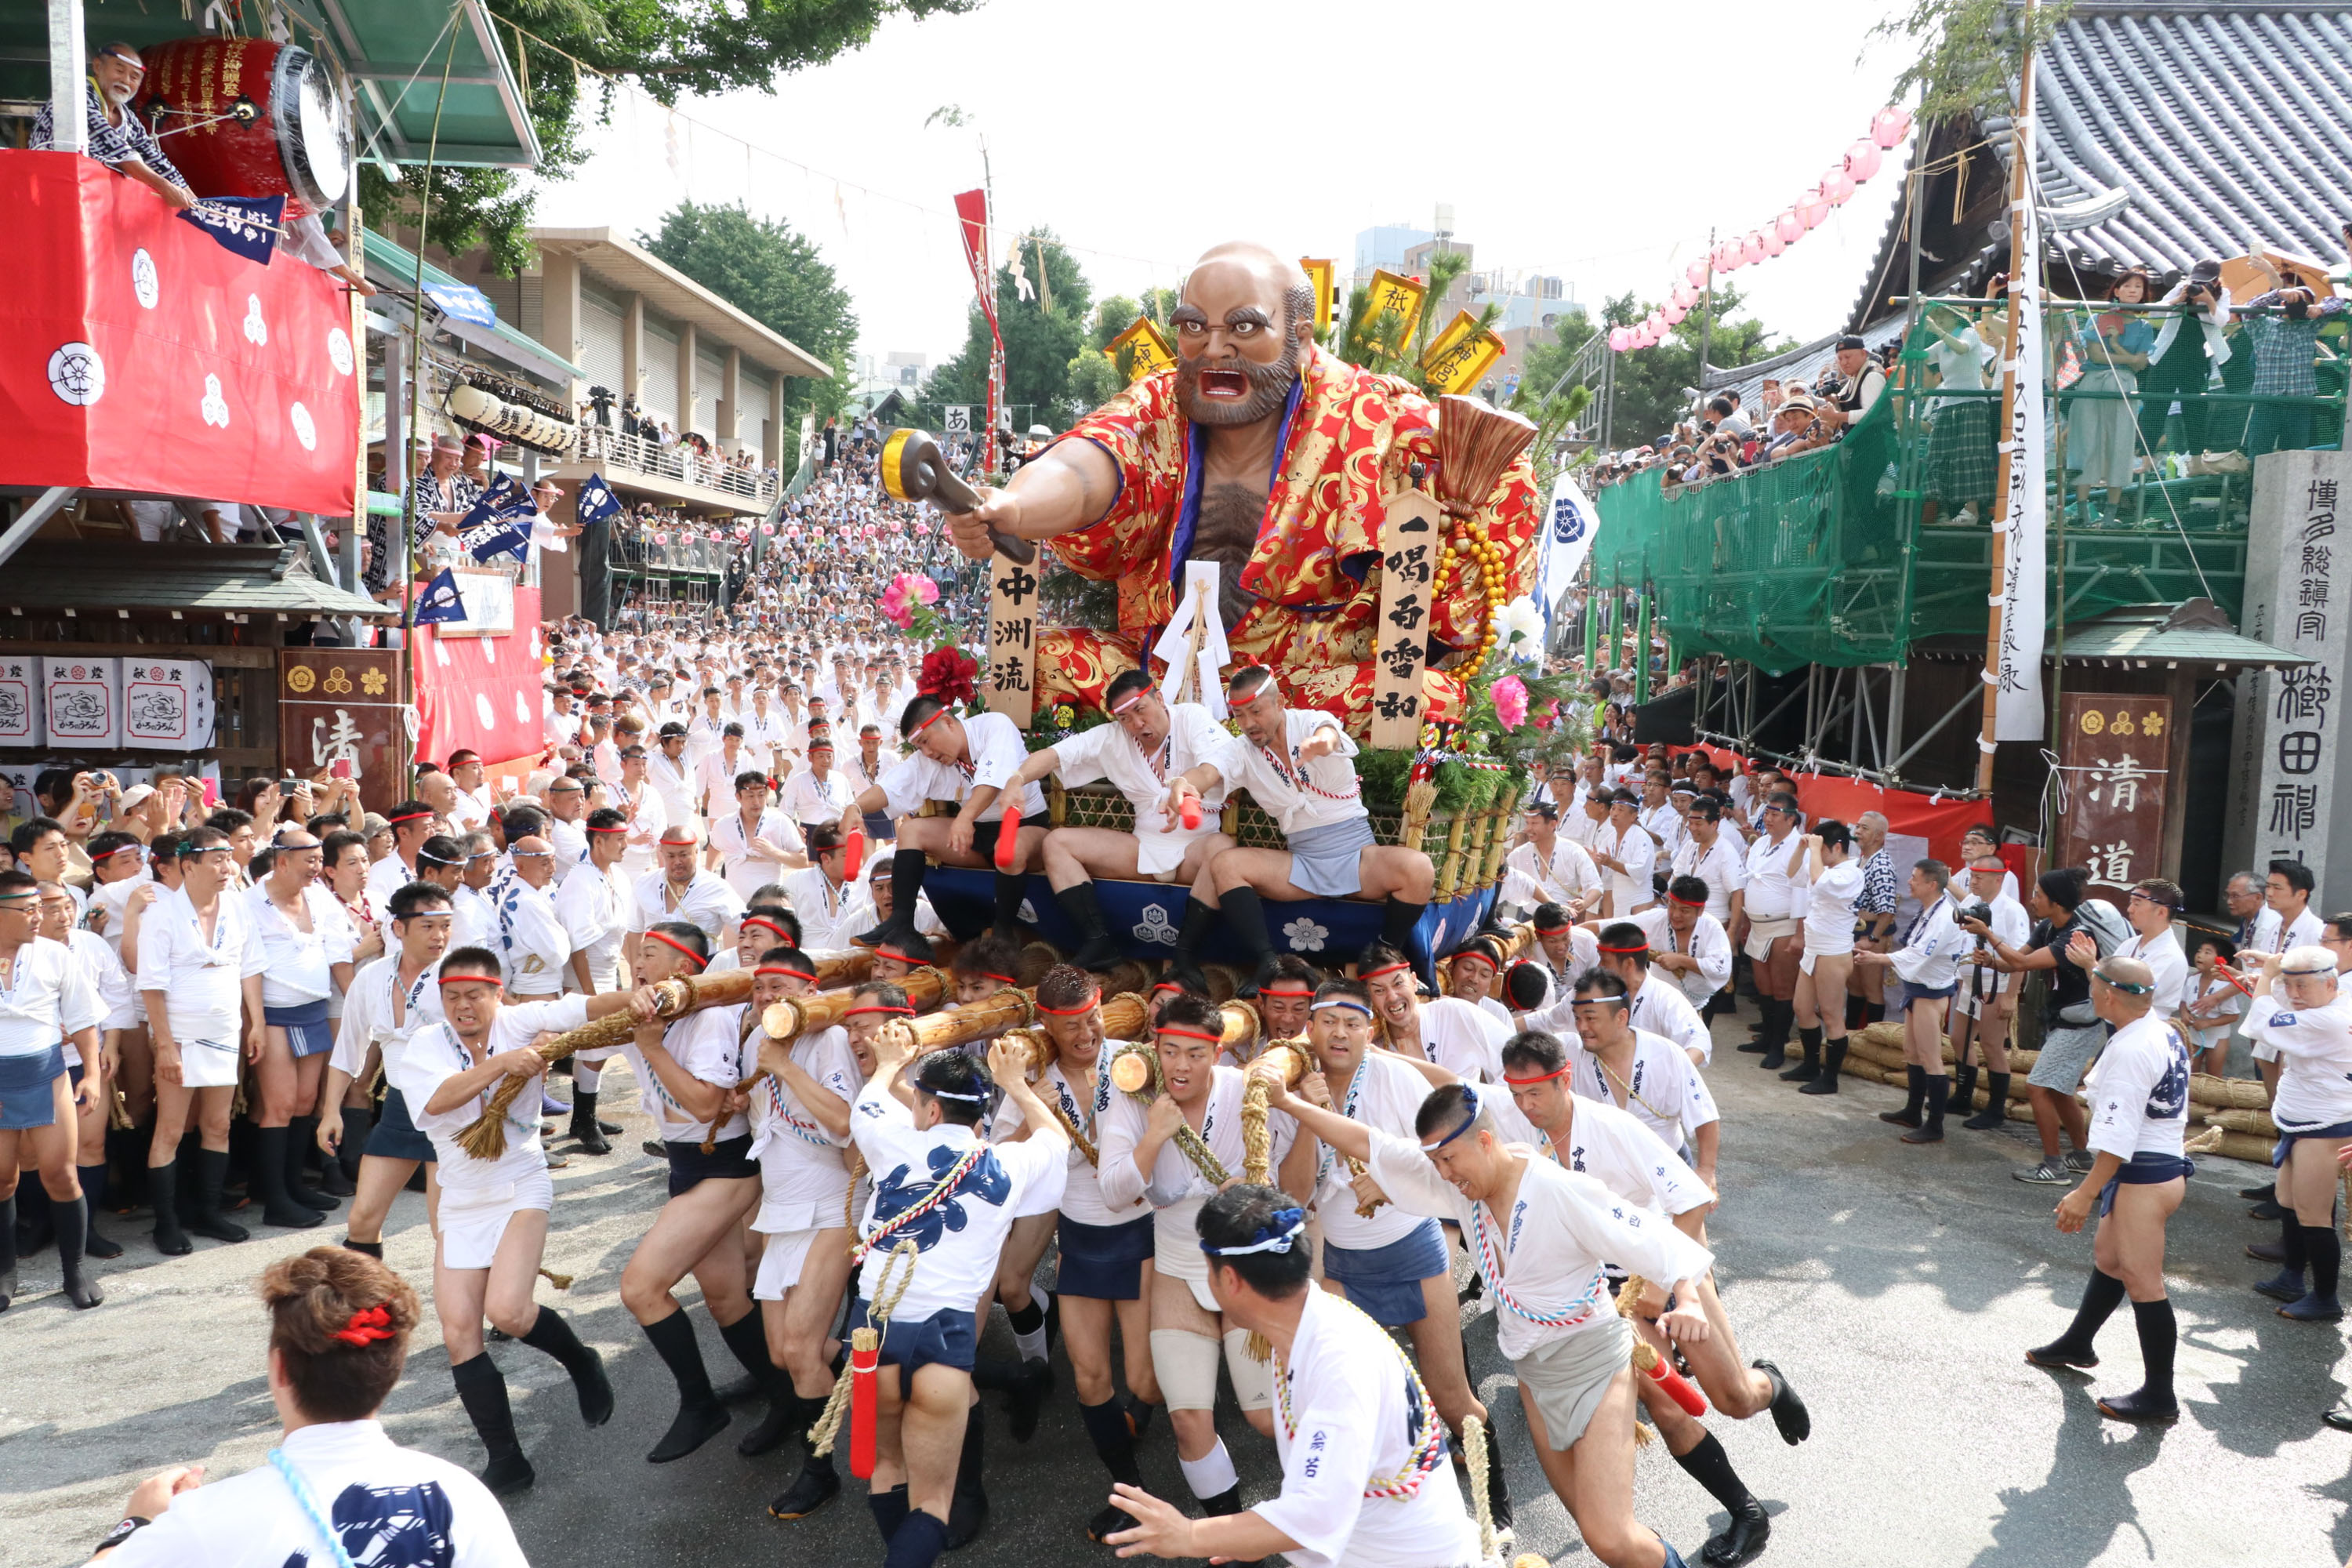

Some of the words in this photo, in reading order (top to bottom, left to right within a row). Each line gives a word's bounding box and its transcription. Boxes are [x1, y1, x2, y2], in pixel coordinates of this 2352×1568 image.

[947, 408, 969, 431] あ
[993, 567, 1037, 692] 中洲流
[2086, 753, 2148, 892] 清道
[2103, 1101, 2119, 1127] 中三
